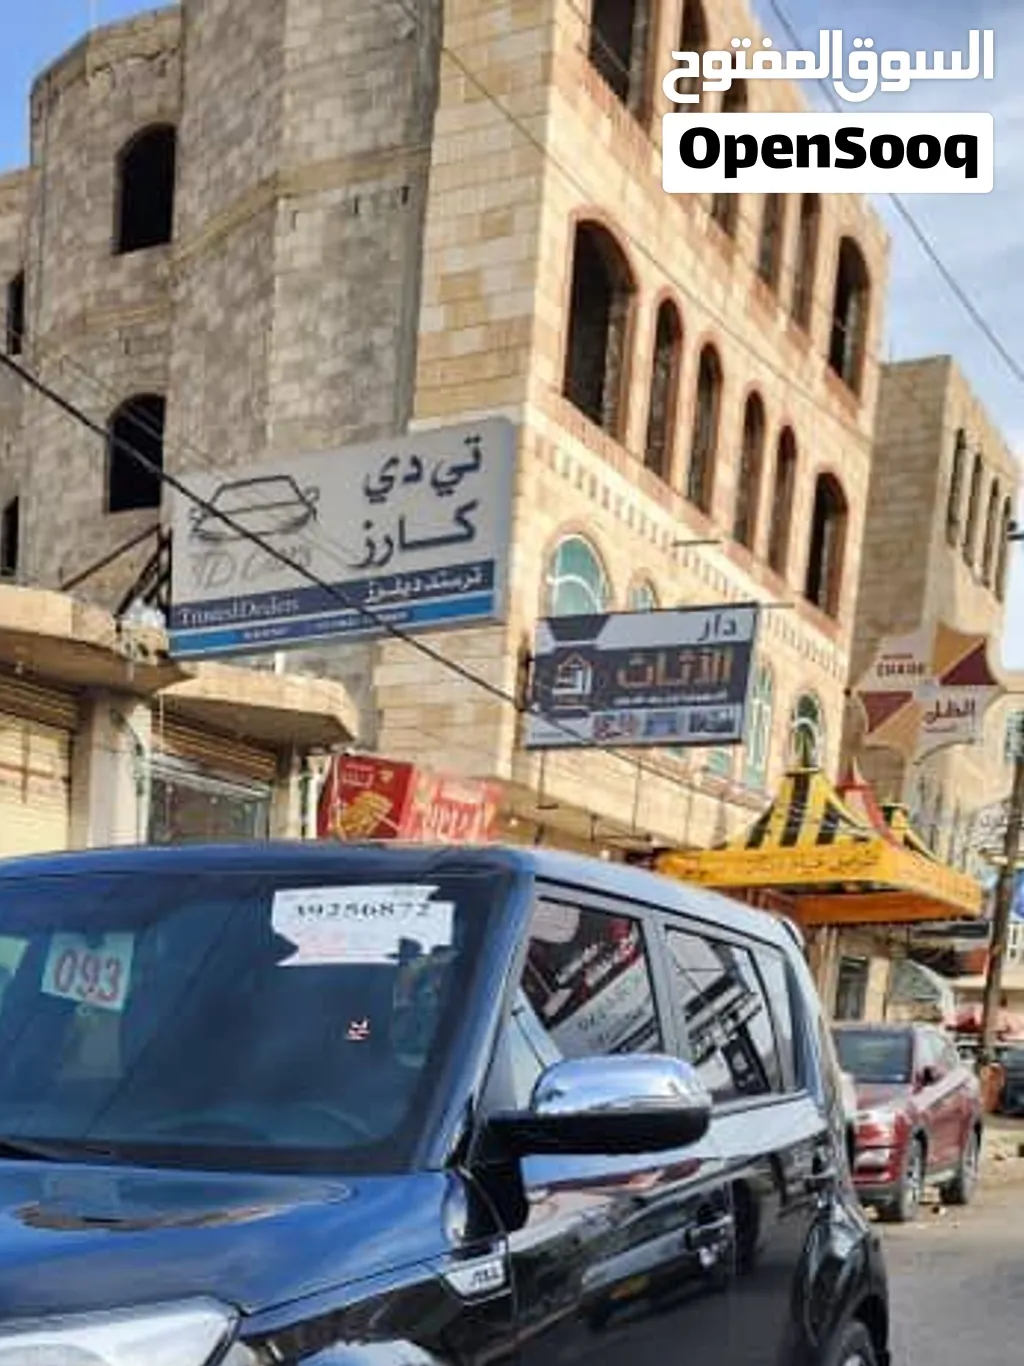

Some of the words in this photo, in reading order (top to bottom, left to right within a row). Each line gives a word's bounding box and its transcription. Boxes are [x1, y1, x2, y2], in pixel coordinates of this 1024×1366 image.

[363, 454, 423, 504] دي
[430, 436, 483, 497] تي
[698, 613, 737, 641] دار
[53, 947, 121, 1003] 093
